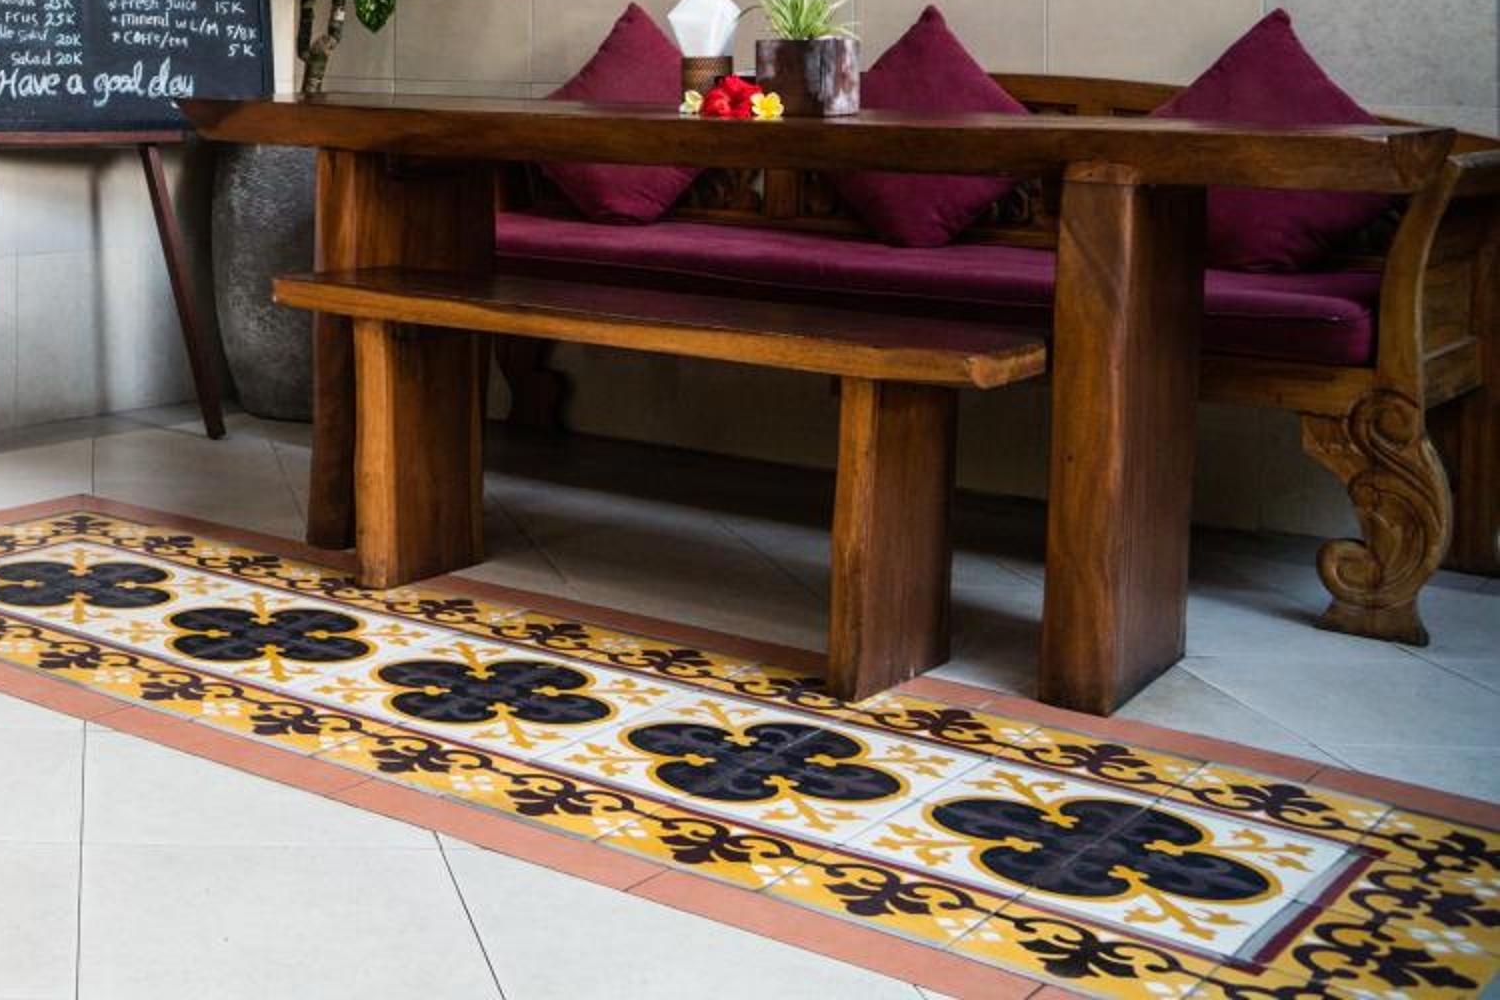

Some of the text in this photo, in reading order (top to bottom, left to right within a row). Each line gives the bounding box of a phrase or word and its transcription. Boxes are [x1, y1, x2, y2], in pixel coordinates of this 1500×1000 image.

[214, 1, 245, 15] 15K
[44, 11, 77, 27] 25K
[55, 32, 83, 47] 20K
[54, 51, 83, 66] 20K
[66, 73, 86, 96] a
[92, 60, 145, 108] good
[149, 56, 195, 109] day
